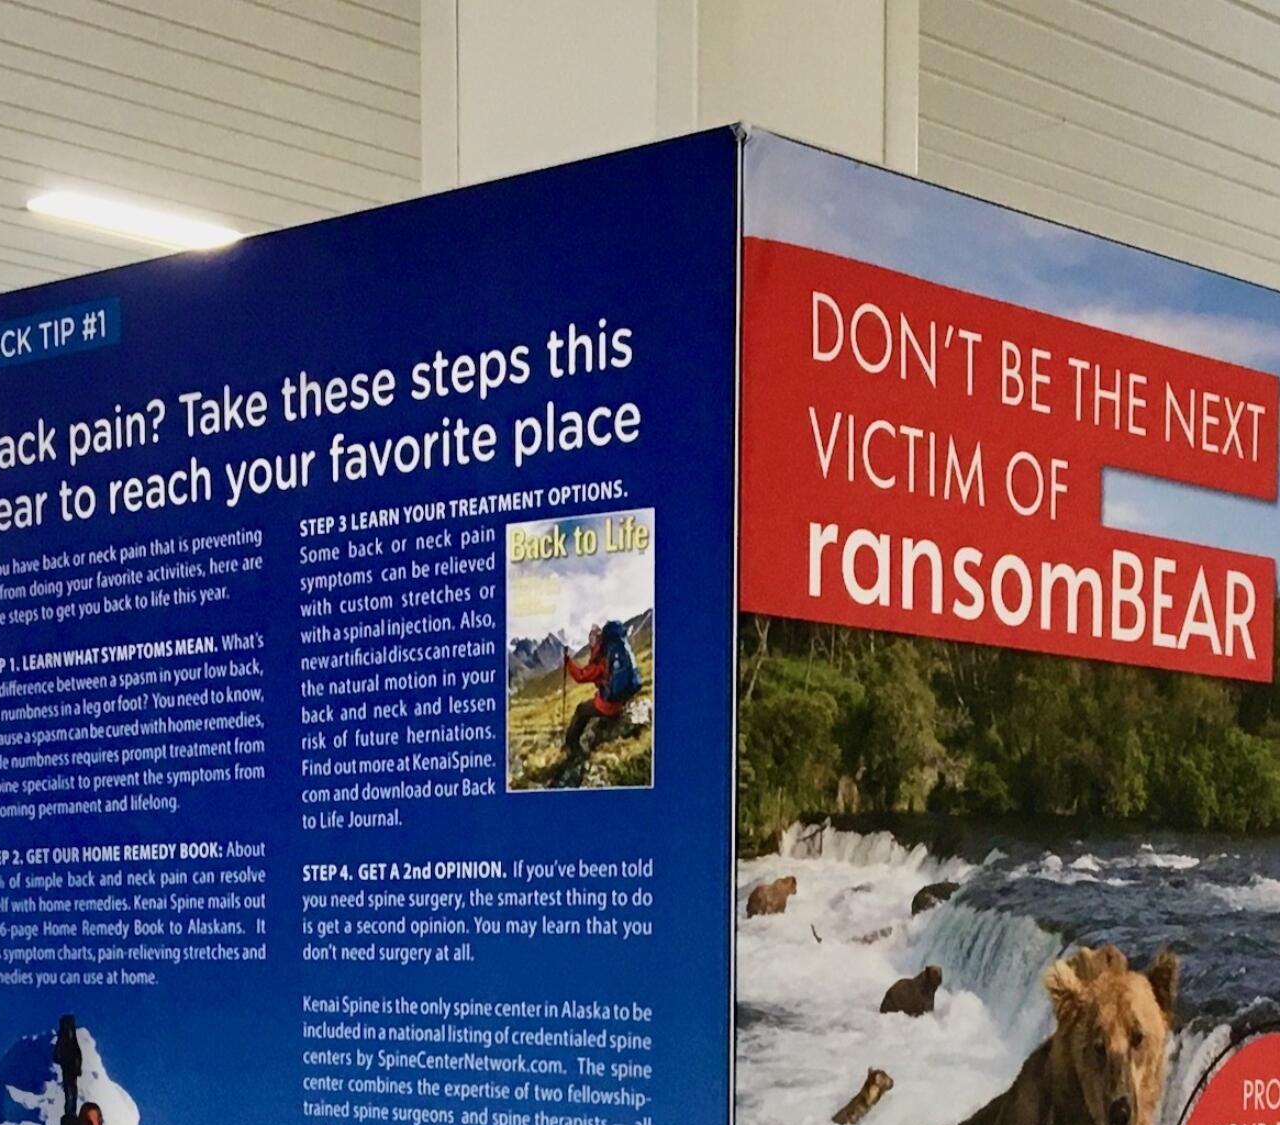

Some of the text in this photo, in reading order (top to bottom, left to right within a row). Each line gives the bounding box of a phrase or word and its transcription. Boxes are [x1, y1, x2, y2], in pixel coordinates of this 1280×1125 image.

[39, 318, 74, 349] TIP
[83, 310, 105, 340] #1
[813, 292, 1265, 461] DON'T BE THE NEXT
[70, 399, 165, 466] pain?
[179, 385, 267, 437] Take
[282, 369, 395, 421] these
[412, 346, 530, 400] steps
[547, 319, 632, 378] this
[59, 481, 95, 521] to
[110, 457, 211, 514] reach
[226, 451, 315, 507] your
[330, 417, 496, 482] favorite
[515, 401, 640, 467] place
[300, 480, 627, 537] STEP 3 LEARN YOUR TREATMENT OPTIONS.
[809, 407, 1068, 520] VICTIM OF
[509, 515, 650, 563] Back to Life
[809, 523, 1256, 659] ransomBEAR
[303, 859, 652, 882] STEP 4. GET A 2nd OPINION. If you've been told
